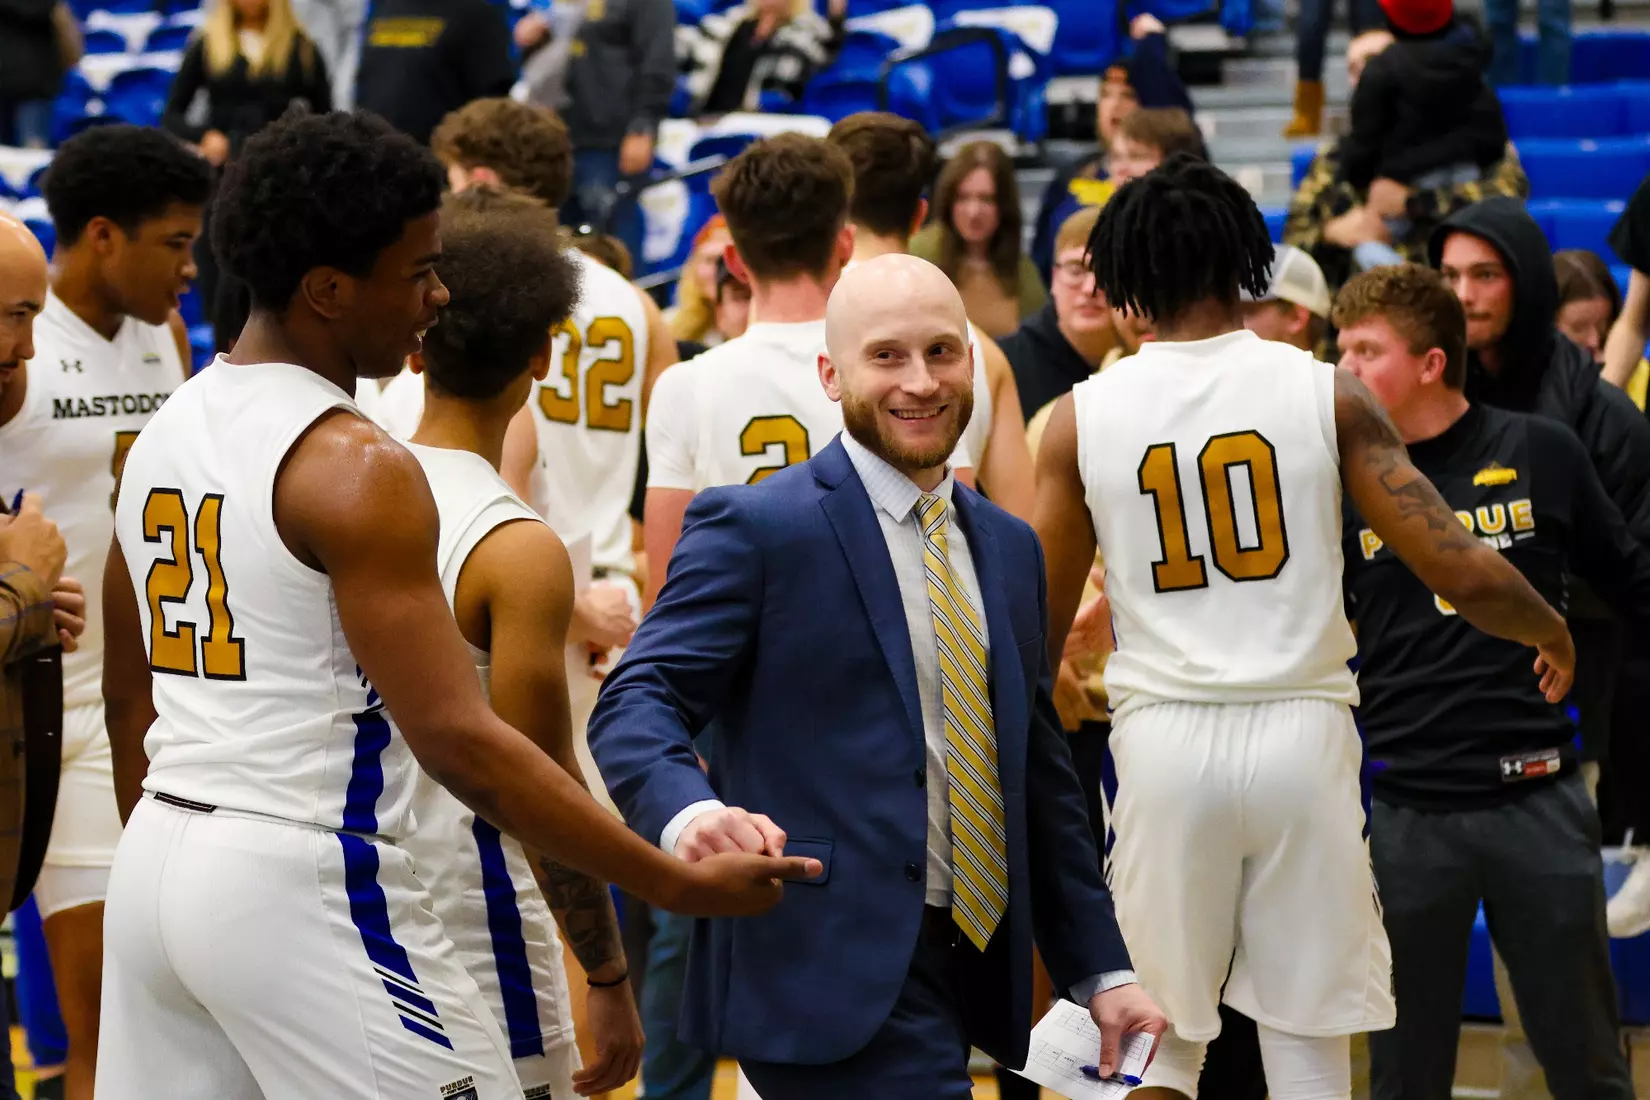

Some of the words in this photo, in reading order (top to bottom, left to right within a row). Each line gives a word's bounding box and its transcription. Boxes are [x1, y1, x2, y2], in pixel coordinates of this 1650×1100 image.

[52, 393, 171, 419] MASTODO
[535, 316, 634, 432] 32
[1137, 429, 1290, 593] 10
[142, 487, 247, 681] 21
